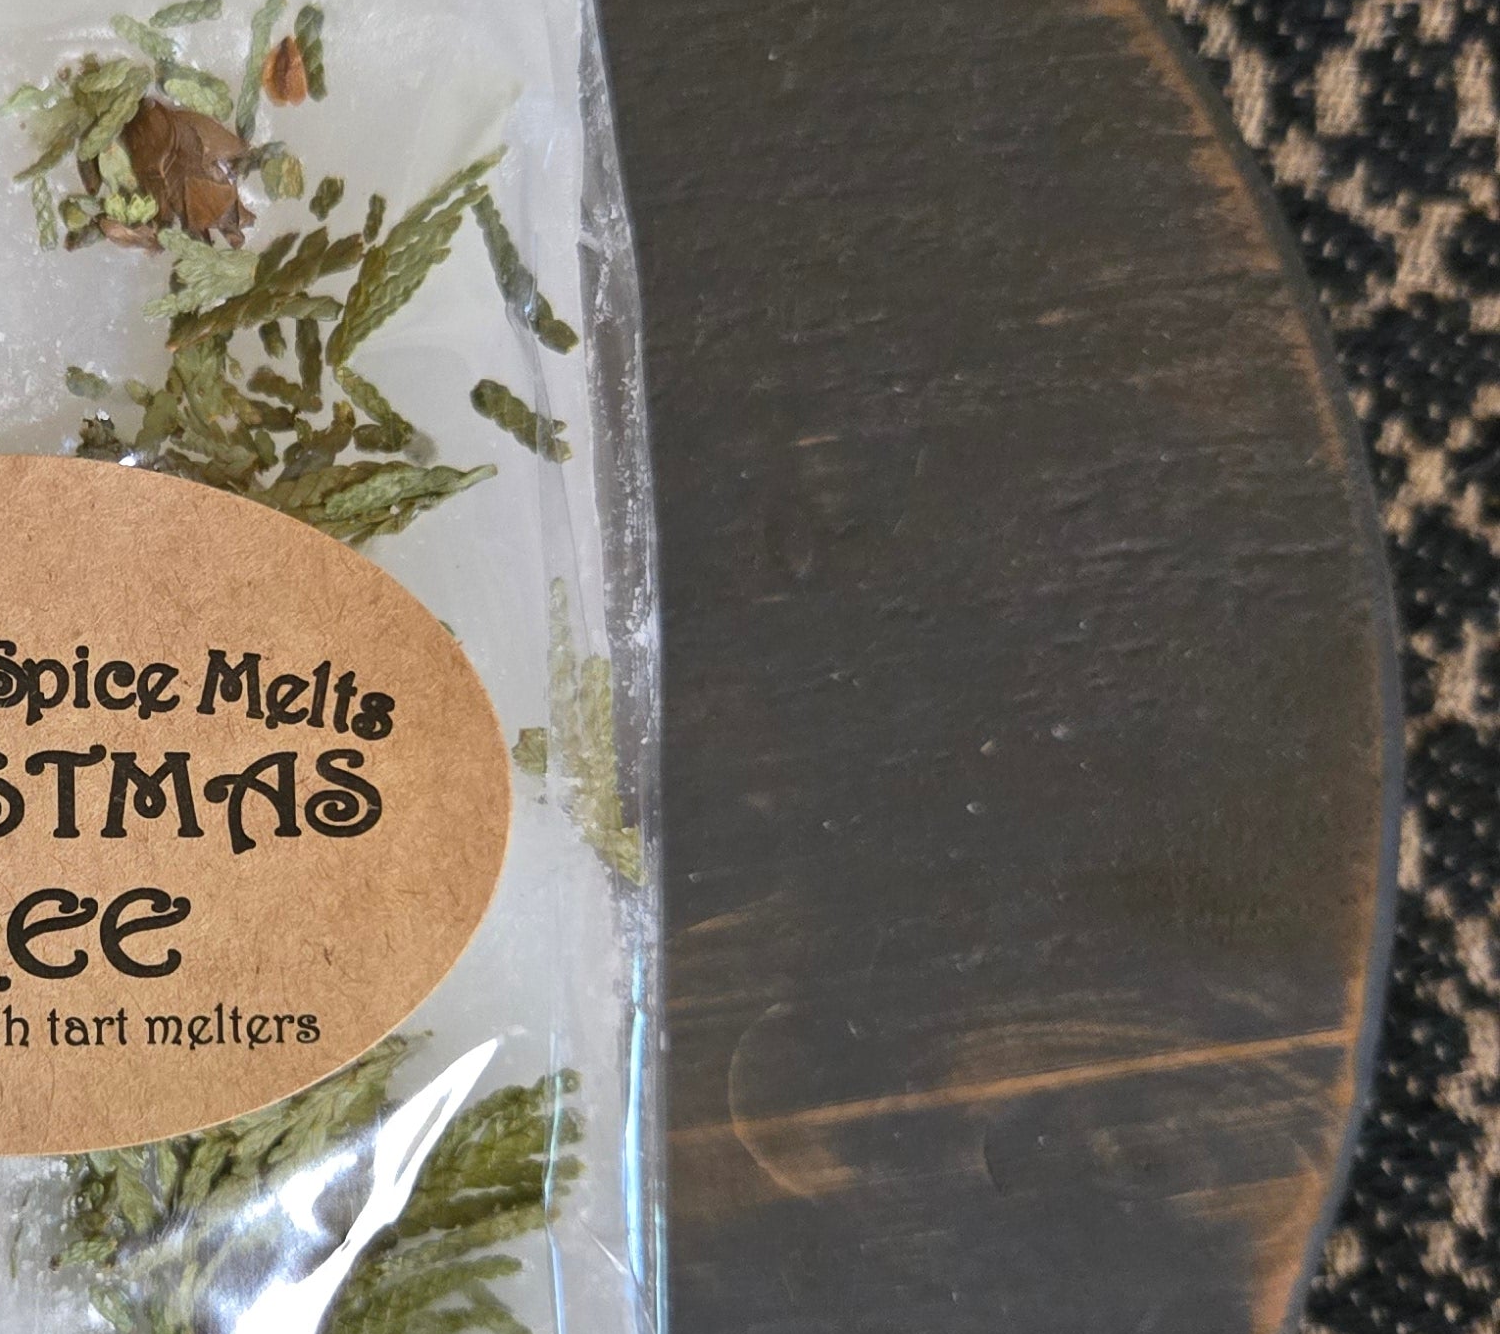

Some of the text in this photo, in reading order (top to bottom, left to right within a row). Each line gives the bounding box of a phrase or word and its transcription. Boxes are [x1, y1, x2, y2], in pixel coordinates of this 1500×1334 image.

[196, 649, 396, 742] Melts
[45, 1006, 129, 1048] tart
[144, 1001, 322, 1052] melters
